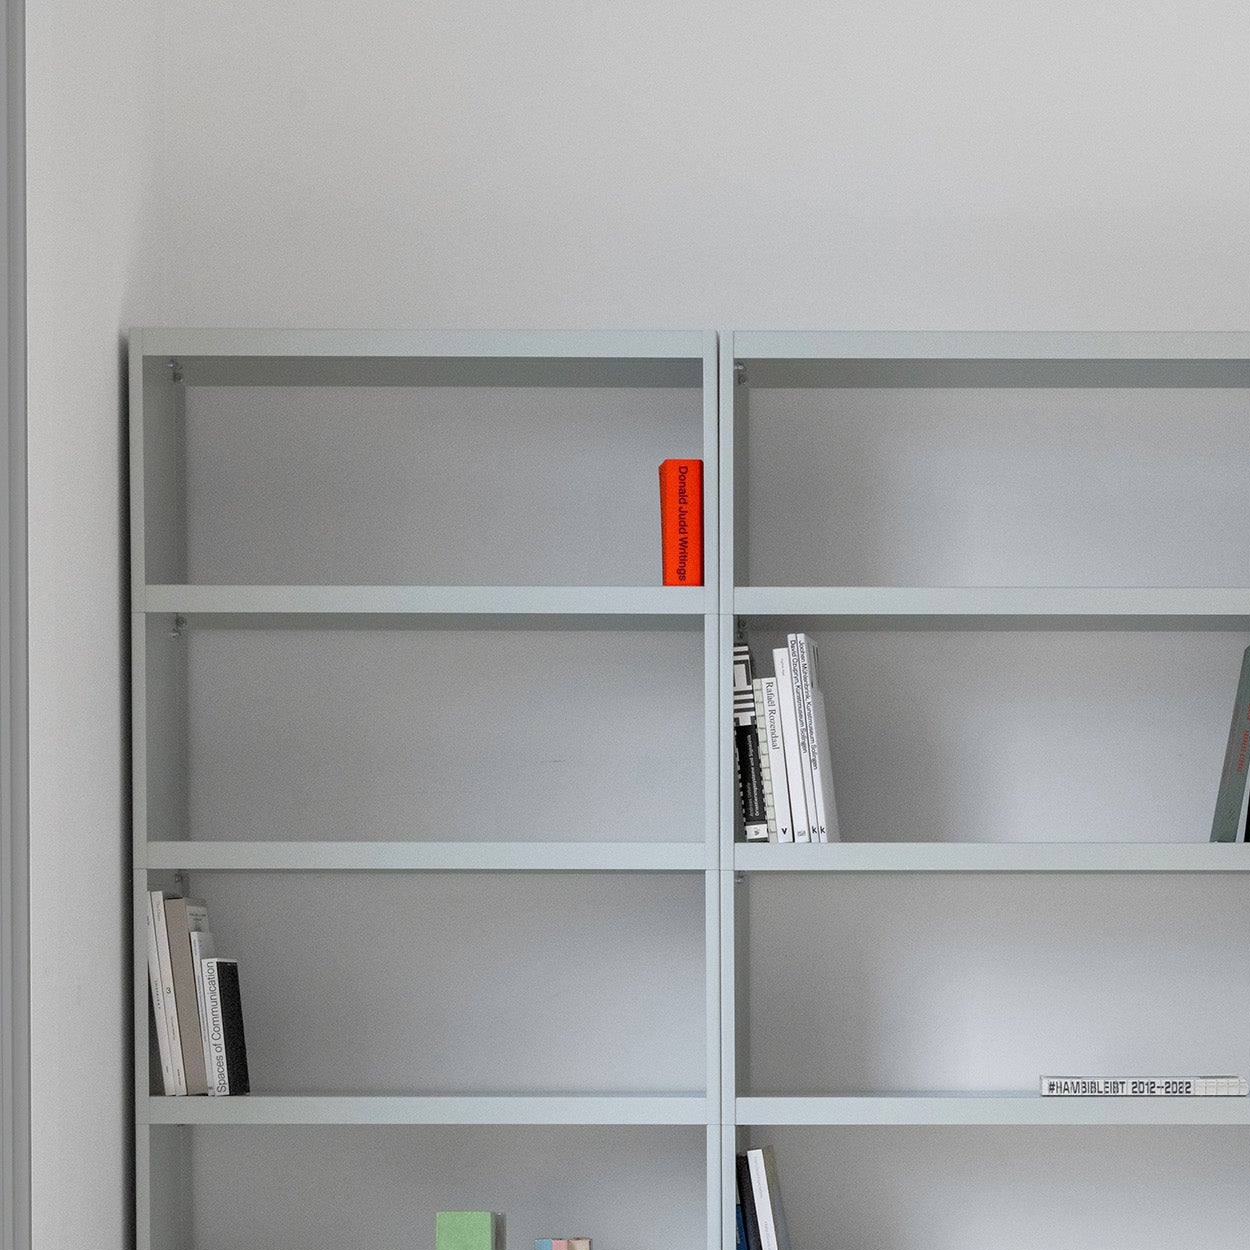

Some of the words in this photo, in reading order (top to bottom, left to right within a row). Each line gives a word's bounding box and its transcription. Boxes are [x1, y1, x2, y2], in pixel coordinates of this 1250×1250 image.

[678, 465, 689, 505] Donald
[678, 506, 689, 535] Judd
[676, 537, 689, 582] Writings
[765, 681, 775, 706] Rafaël
[795, 684, 805, 728] Kunstmuseum
[768, 709, 779, 749] Rozendaal
[799, 727, 807, 754] Solingen
[805, 701, 816, 744] Kunstmuseum
[810, 744, 818, 770] Solingen
[206, 961, 222, 1041] Communication
[212, 1042, 223, 1054] of
[215, 1054, 228, 1093] Spaces
[1048, 1081, 1126, 1094] #HAMBIBLEIBT
